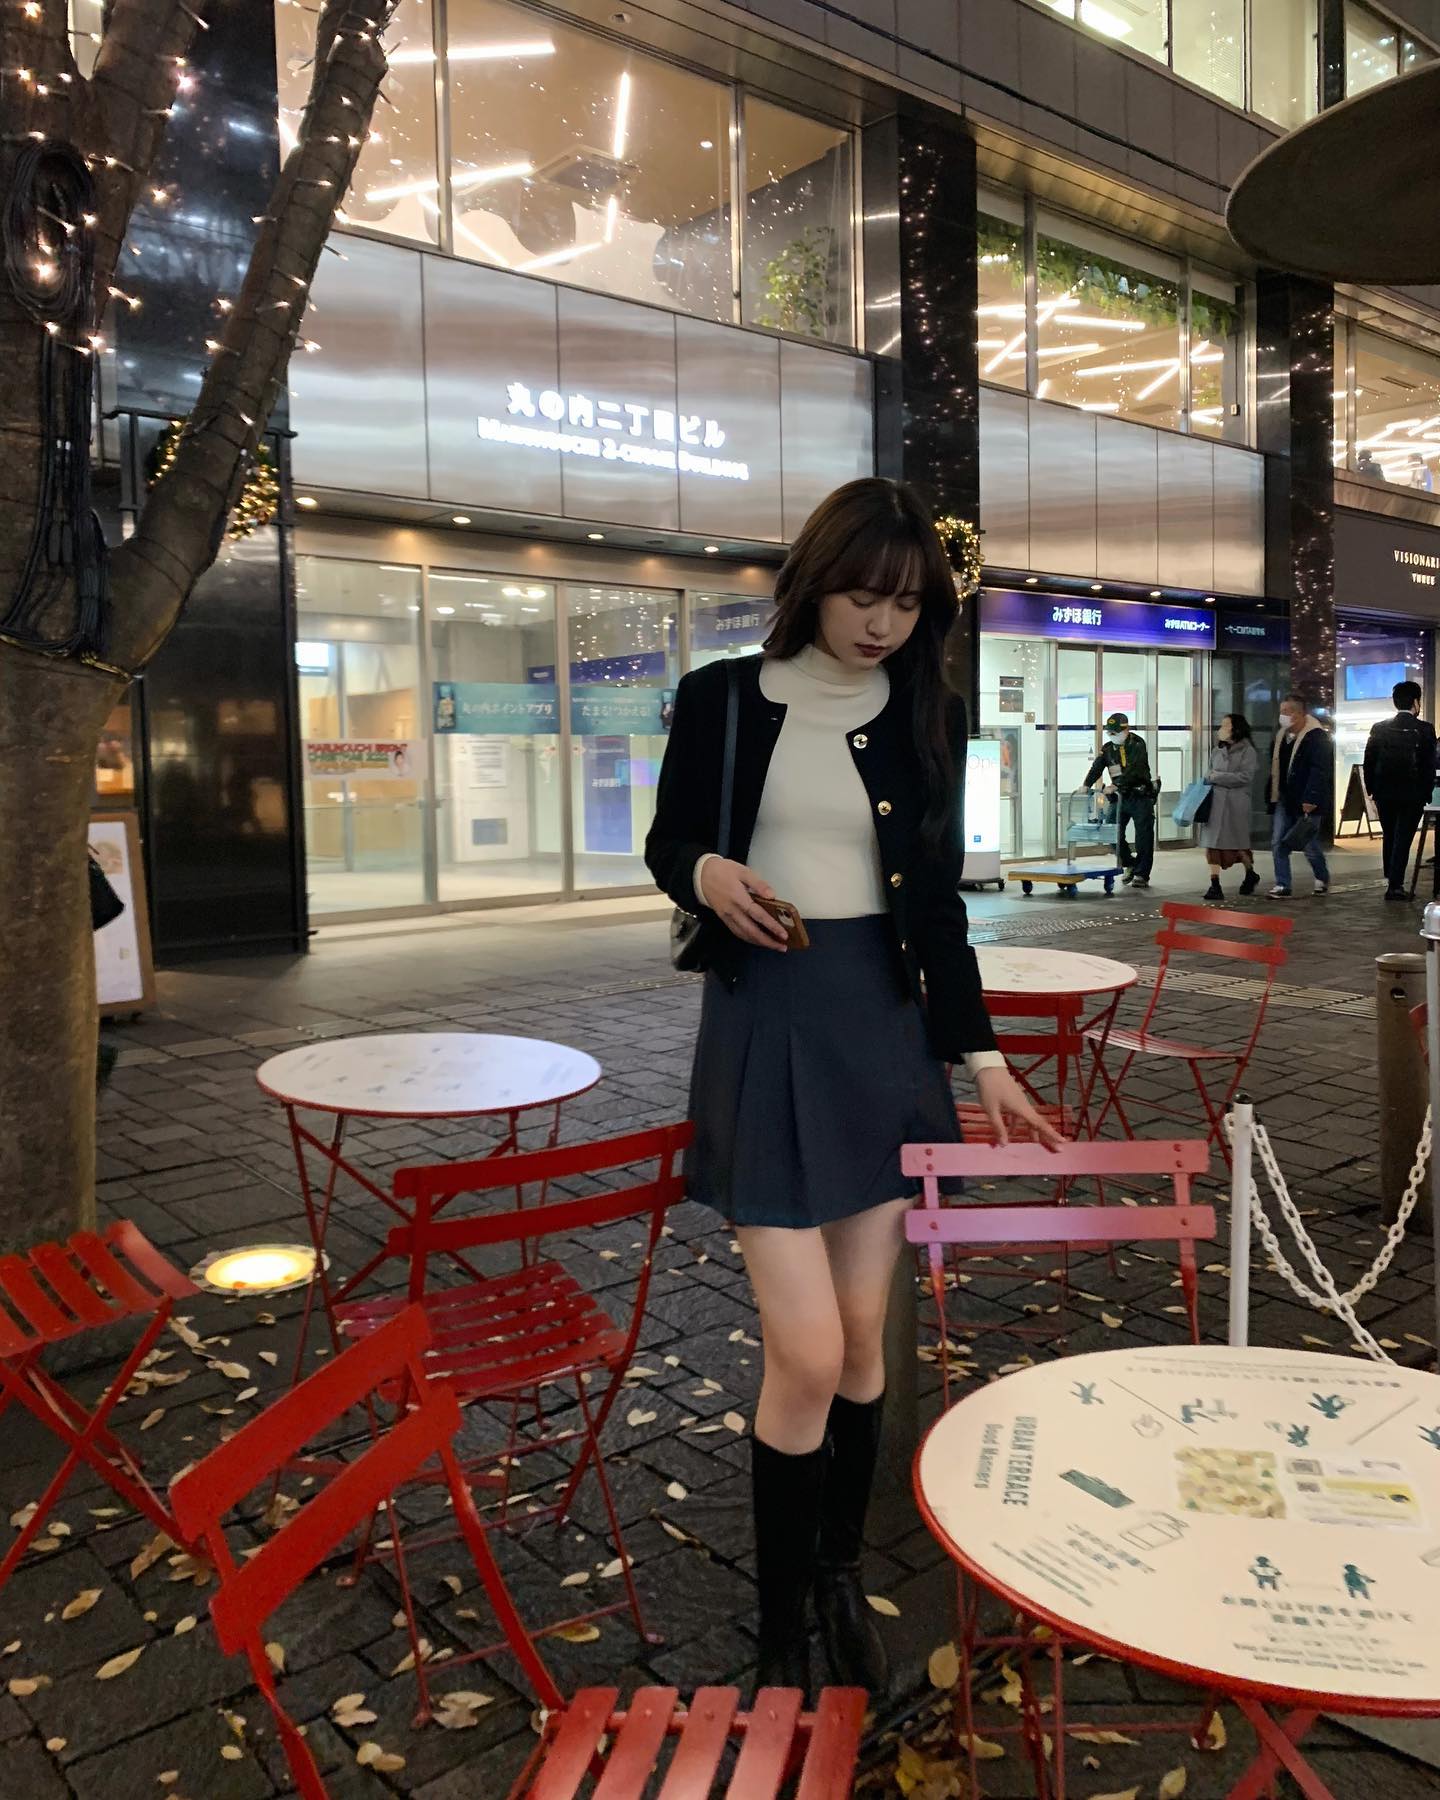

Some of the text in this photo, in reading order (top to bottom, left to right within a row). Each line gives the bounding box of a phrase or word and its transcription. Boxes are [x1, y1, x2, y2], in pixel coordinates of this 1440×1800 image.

[1412, 573, 1436, 586] THREE
[1052, 606, 1102, 626] みずほ銀行
[1002, 1454, 1033, 1506] TERRACE
